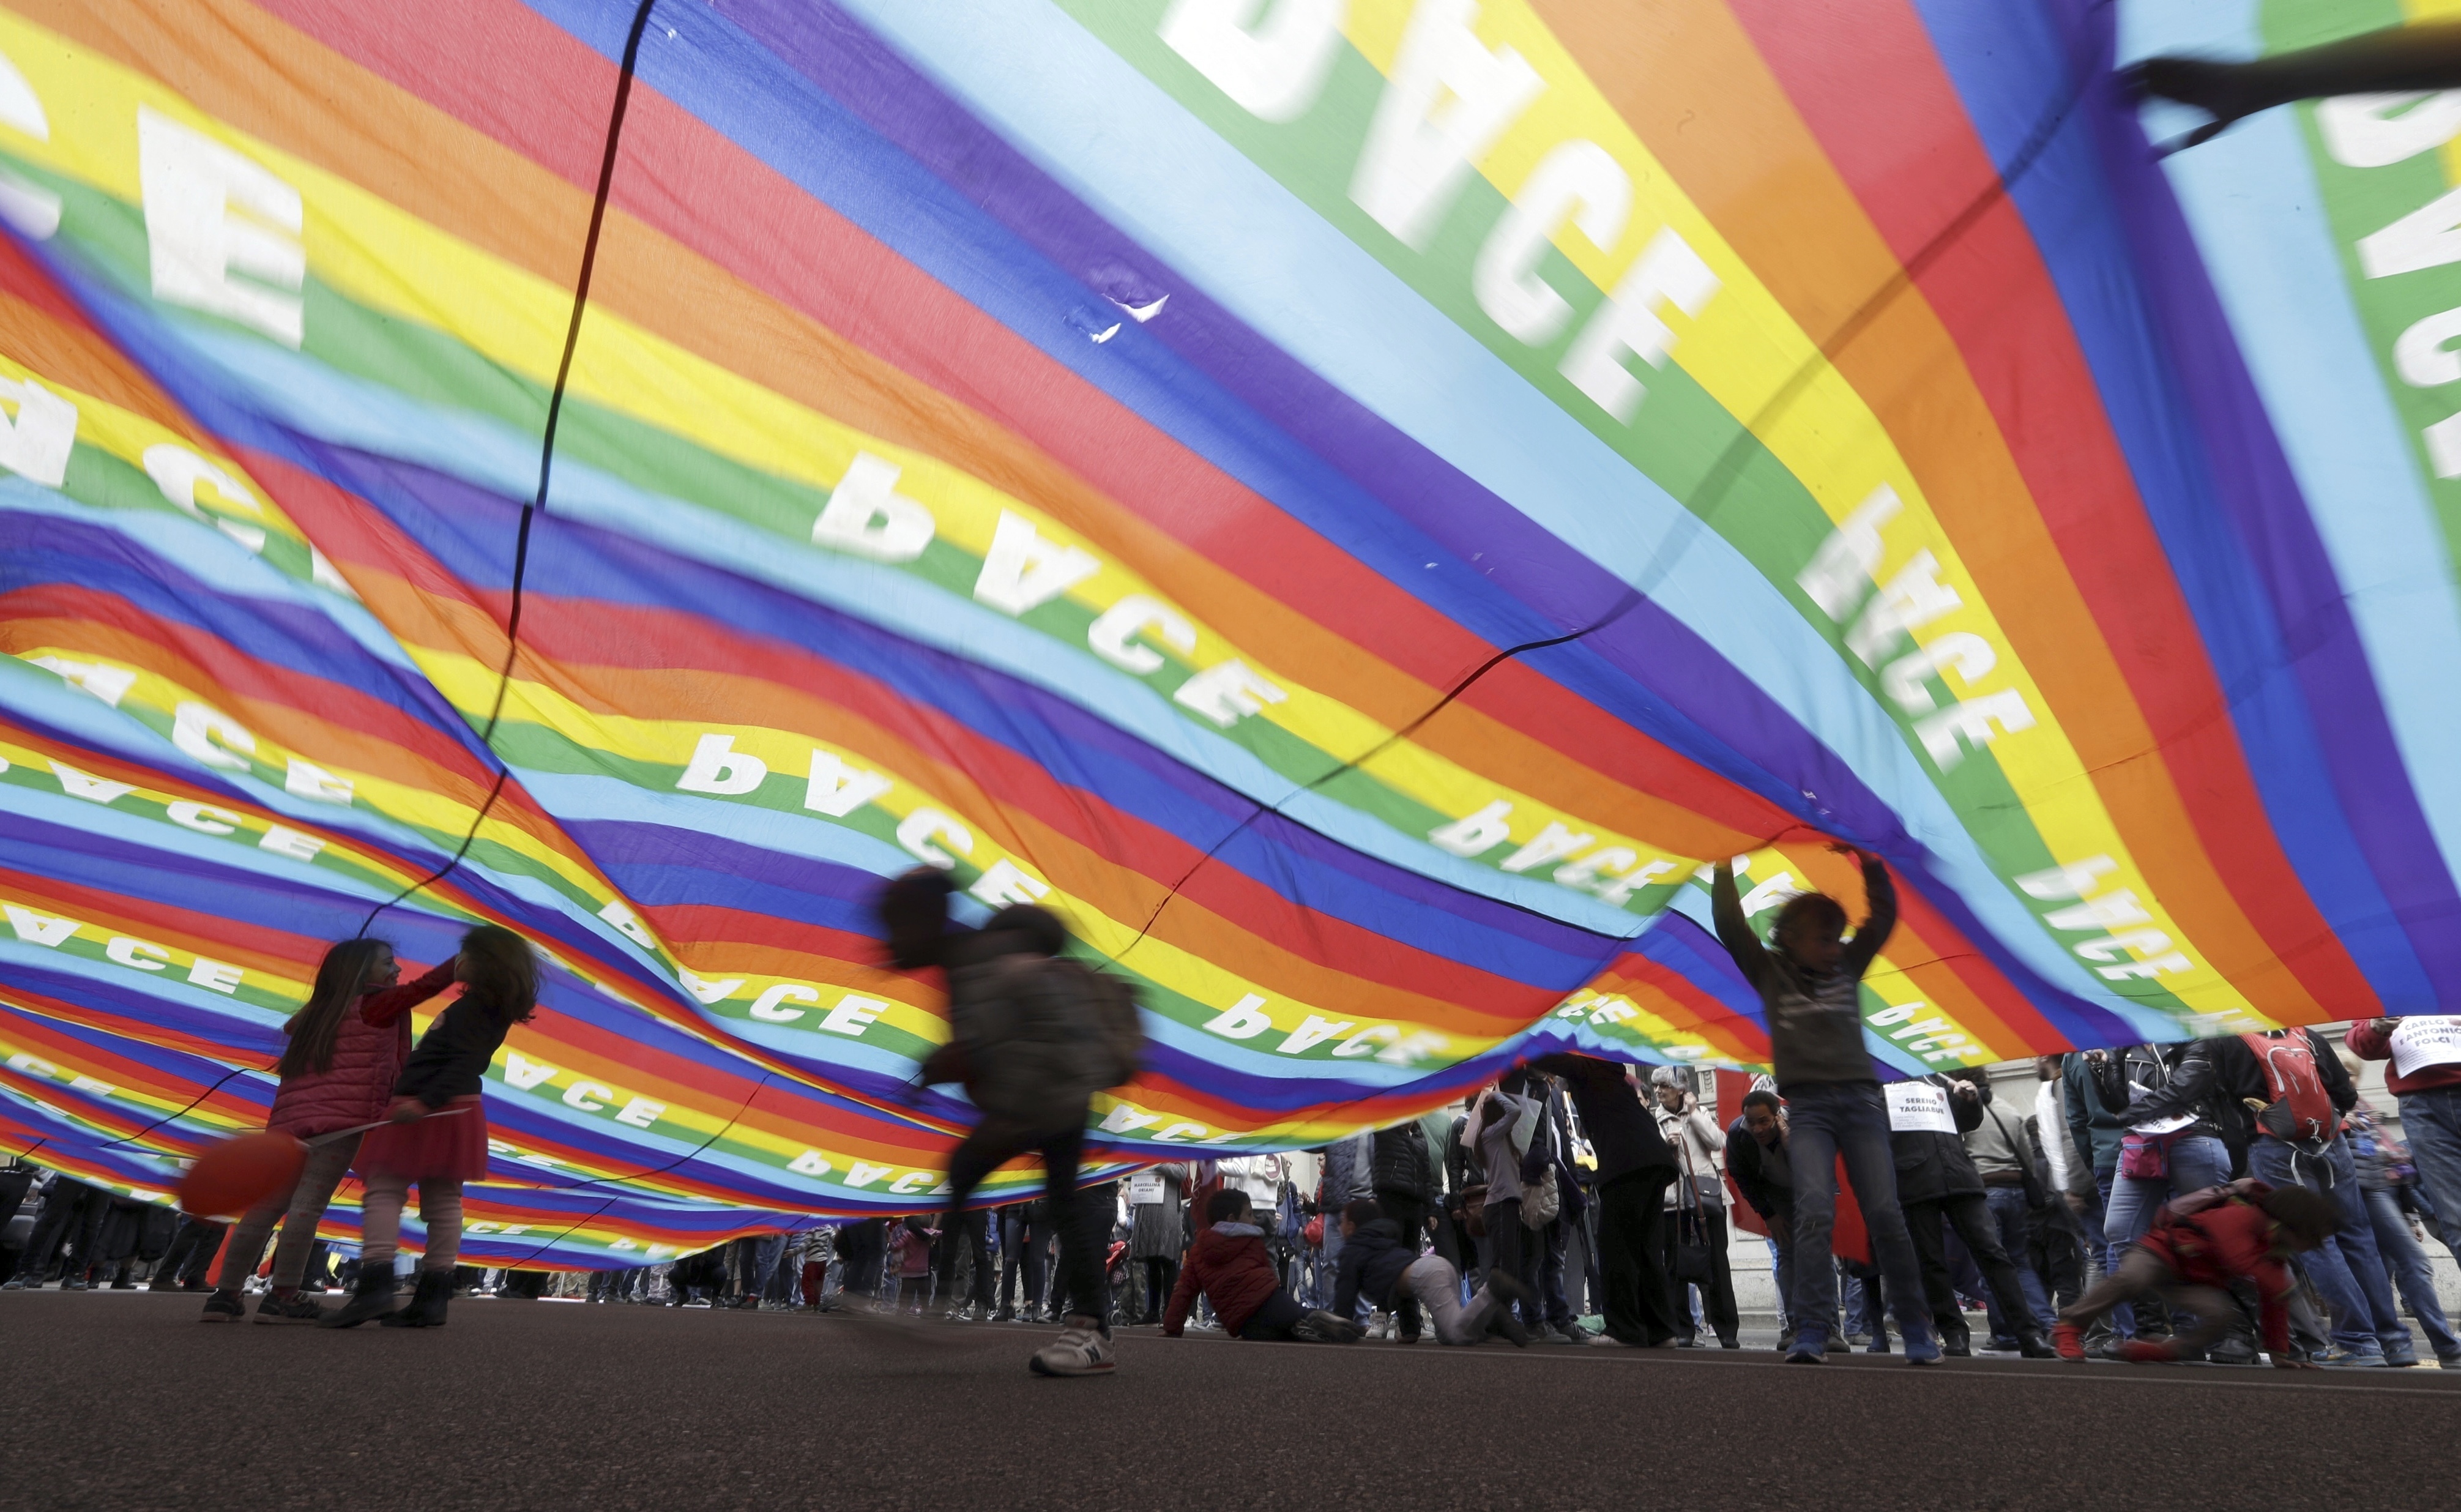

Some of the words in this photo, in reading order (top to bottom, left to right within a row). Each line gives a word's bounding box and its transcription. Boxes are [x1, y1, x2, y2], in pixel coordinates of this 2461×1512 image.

[2405, 1019, 2444, 1030] CARLO
[2414, 1036, 2451, 1047] FOLCI
[1899, 1105, 1945, 1114] TAGLIABUE
